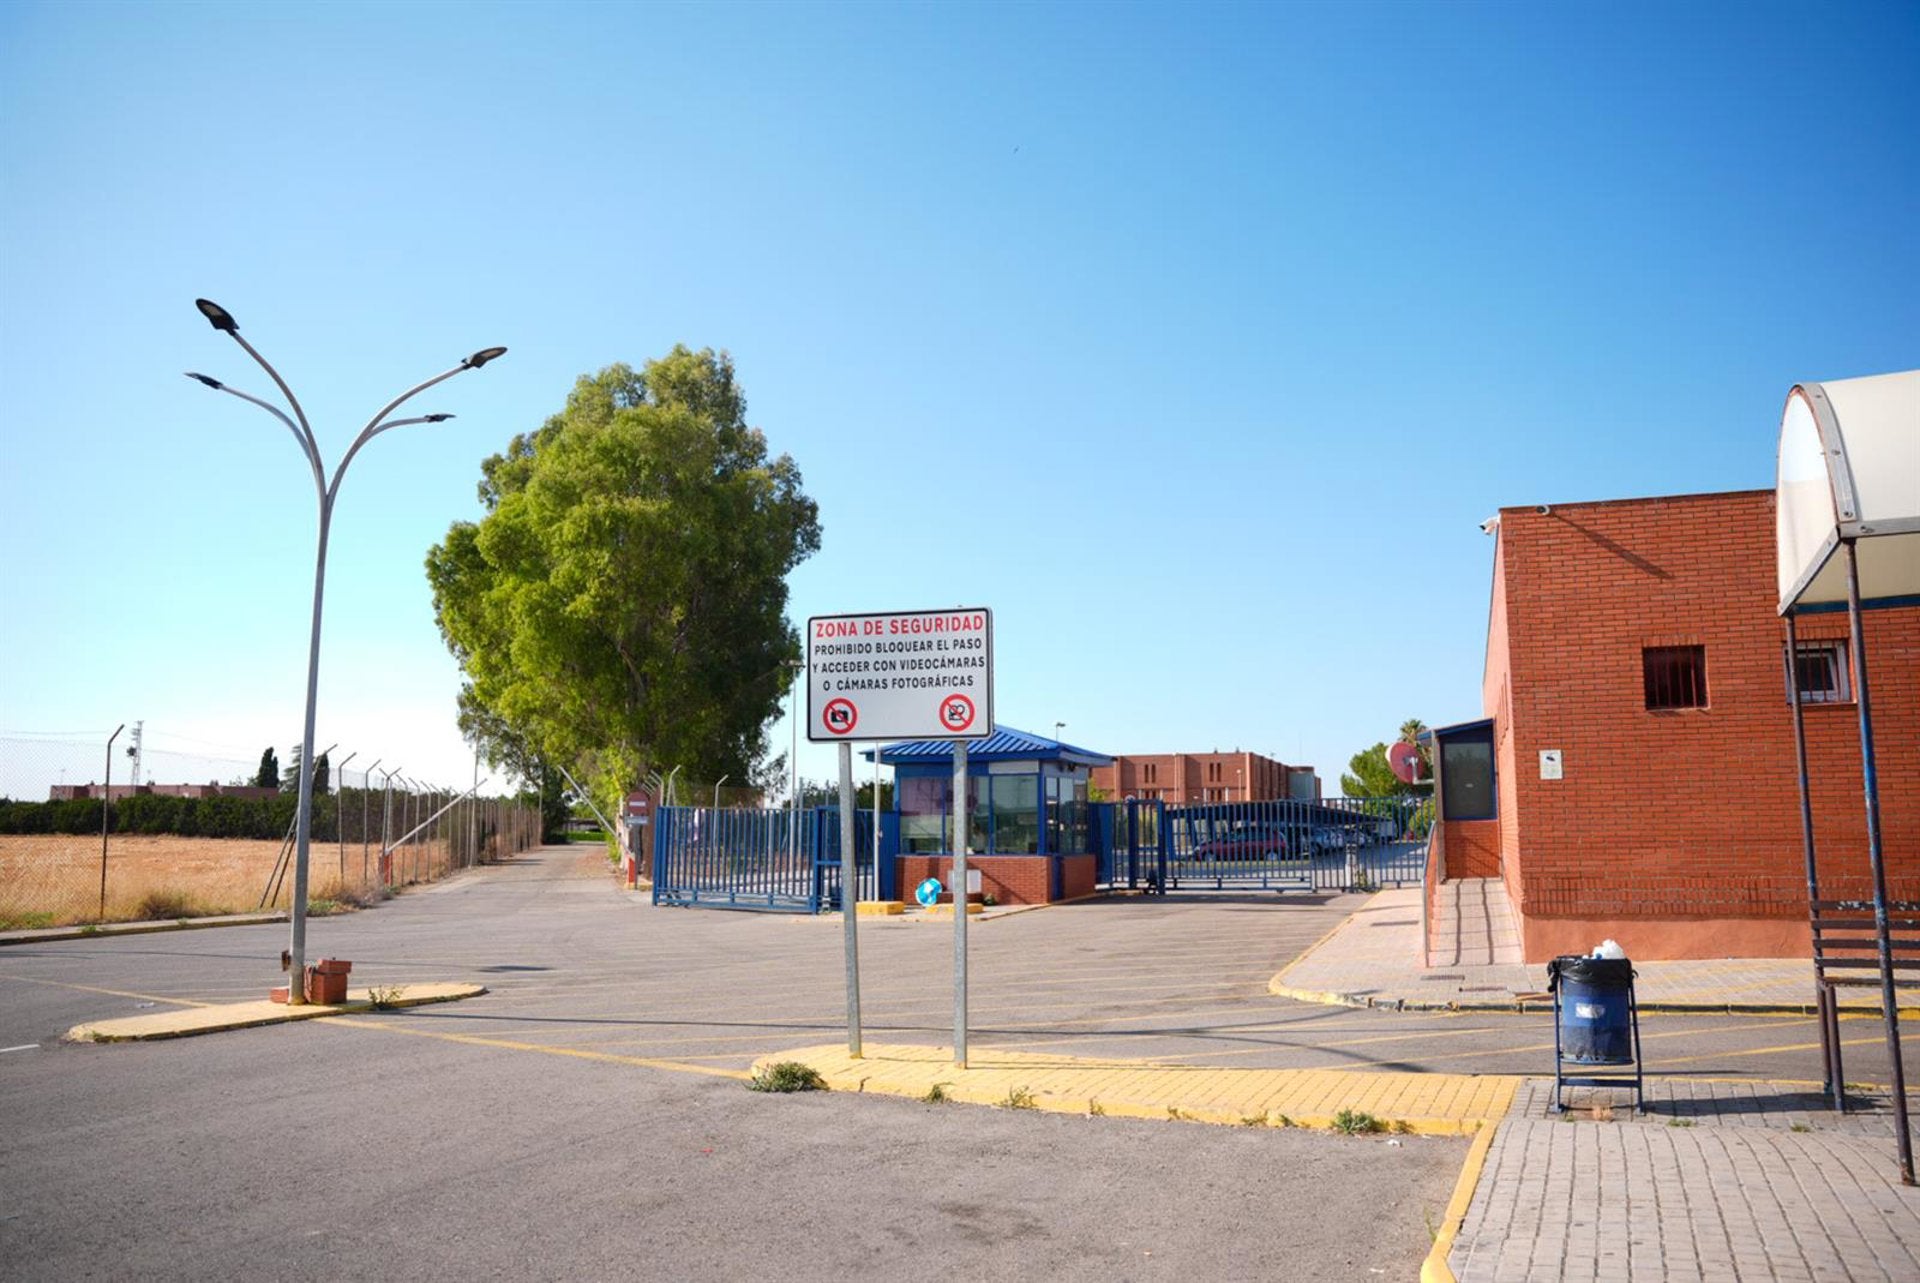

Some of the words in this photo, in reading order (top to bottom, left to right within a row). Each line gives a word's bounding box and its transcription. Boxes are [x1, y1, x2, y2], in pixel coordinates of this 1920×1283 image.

[816, 621, 857, 638] ZONA
[864, 620, 883, 635] DE
[890, 615, 983, 634] SEGURIDAD
[815, 642, 871, 655] PROHIBIDO
[876, 642, 933, 653] BLOQUEAR
[938, 639, 949, 650] EL
[953, 638, 981, 649] PASO
[813, 663, 818, 673] Y
[822, 661, 869, 672] ACCEDER
[874, 660, 896, 671] CON
[900, 655, 984, 670] VIDEOCÁMARAS
[823, 681, 830, 691] O
[837, 677, 888, 690] CÁMARAS
[892, 675, 973, 689] FOTOGRÁFICAS
